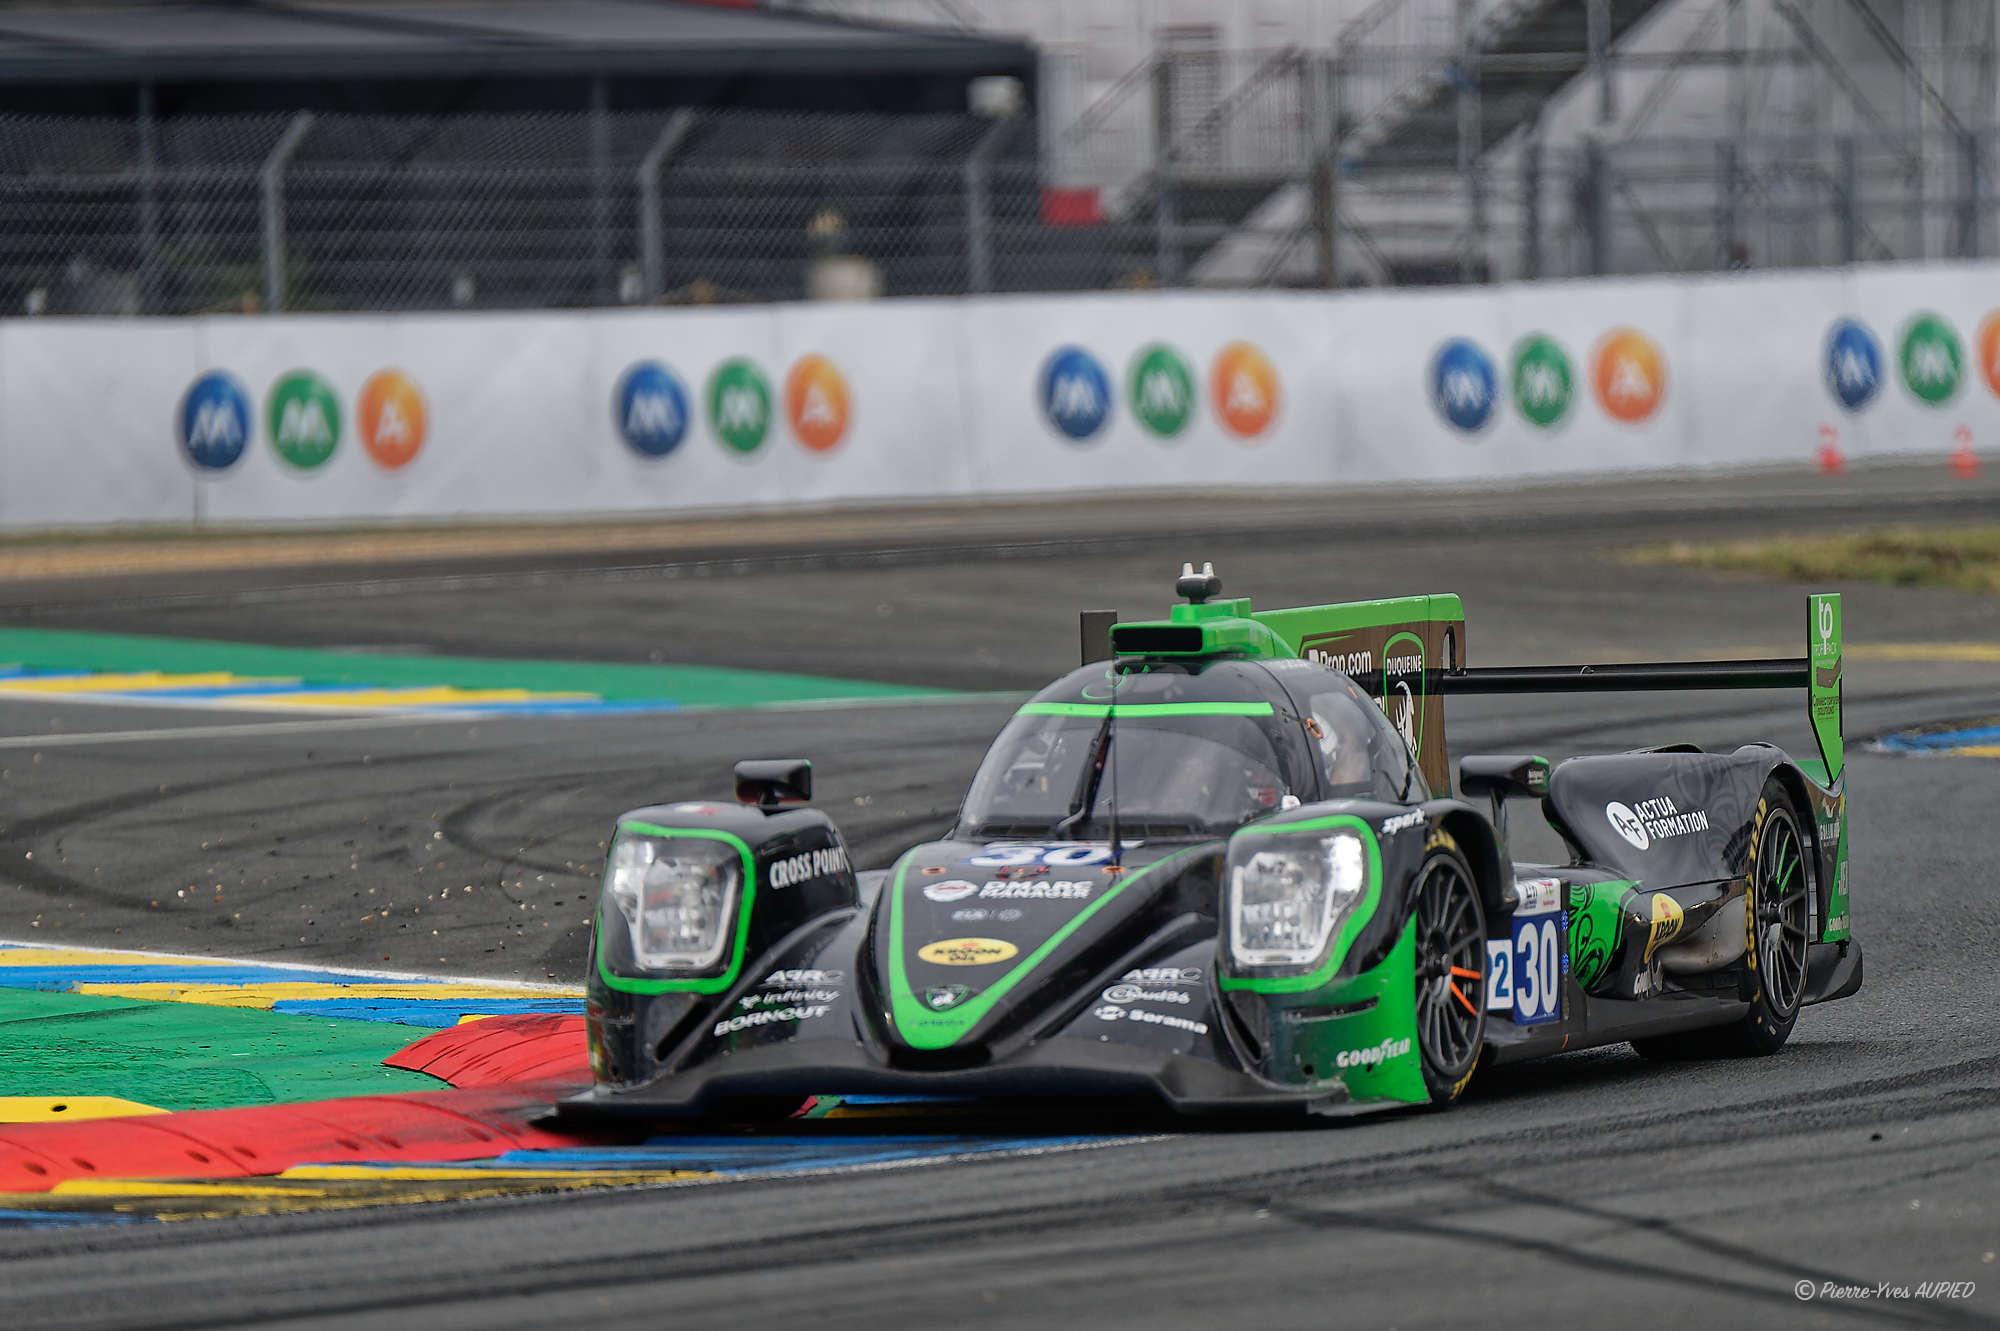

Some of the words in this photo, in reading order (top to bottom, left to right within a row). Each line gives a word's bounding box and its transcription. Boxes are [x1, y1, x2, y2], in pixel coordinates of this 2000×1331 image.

[1386, 655, 1422, 676] DUQUEINE
[1634, 796, 1678, 823] ACTUA
[1645, 810, 1710, 840] FORMATION
[969, 846, 1113, 867] 30
[769, 852, 812, 890] CROSS
[1516, 919, 1559, 1018] 30
